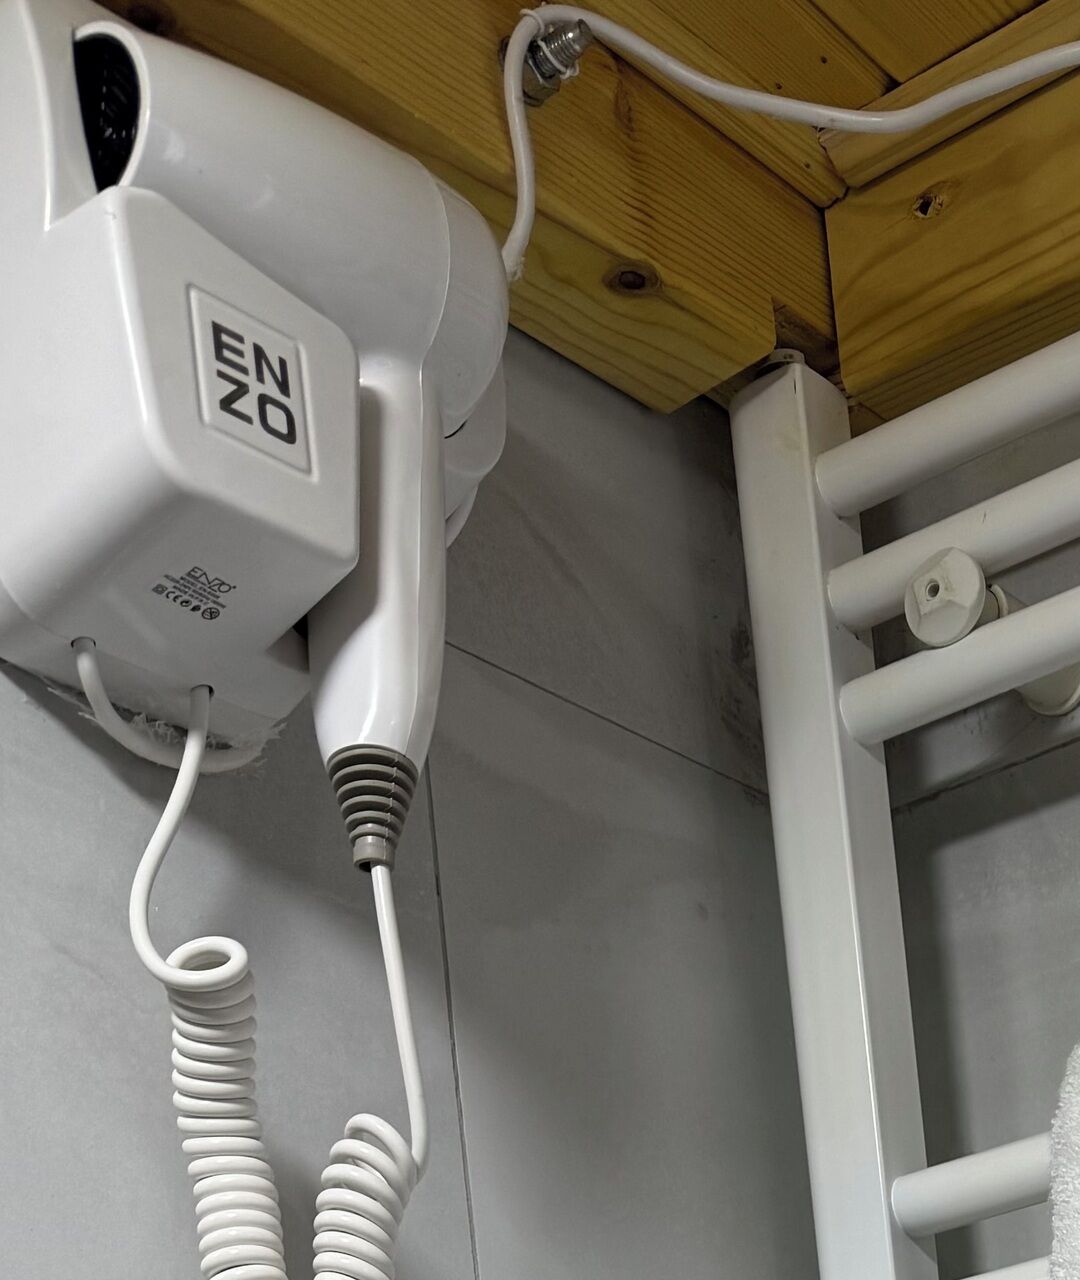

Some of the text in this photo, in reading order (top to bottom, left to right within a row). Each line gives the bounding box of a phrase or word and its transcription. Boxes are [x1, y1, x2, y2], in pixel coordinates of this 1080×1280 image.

[211, 320, 291, 399] EN
[216, 368, 297, 445] ZO
[187, 566, 231, 593] ENZO
